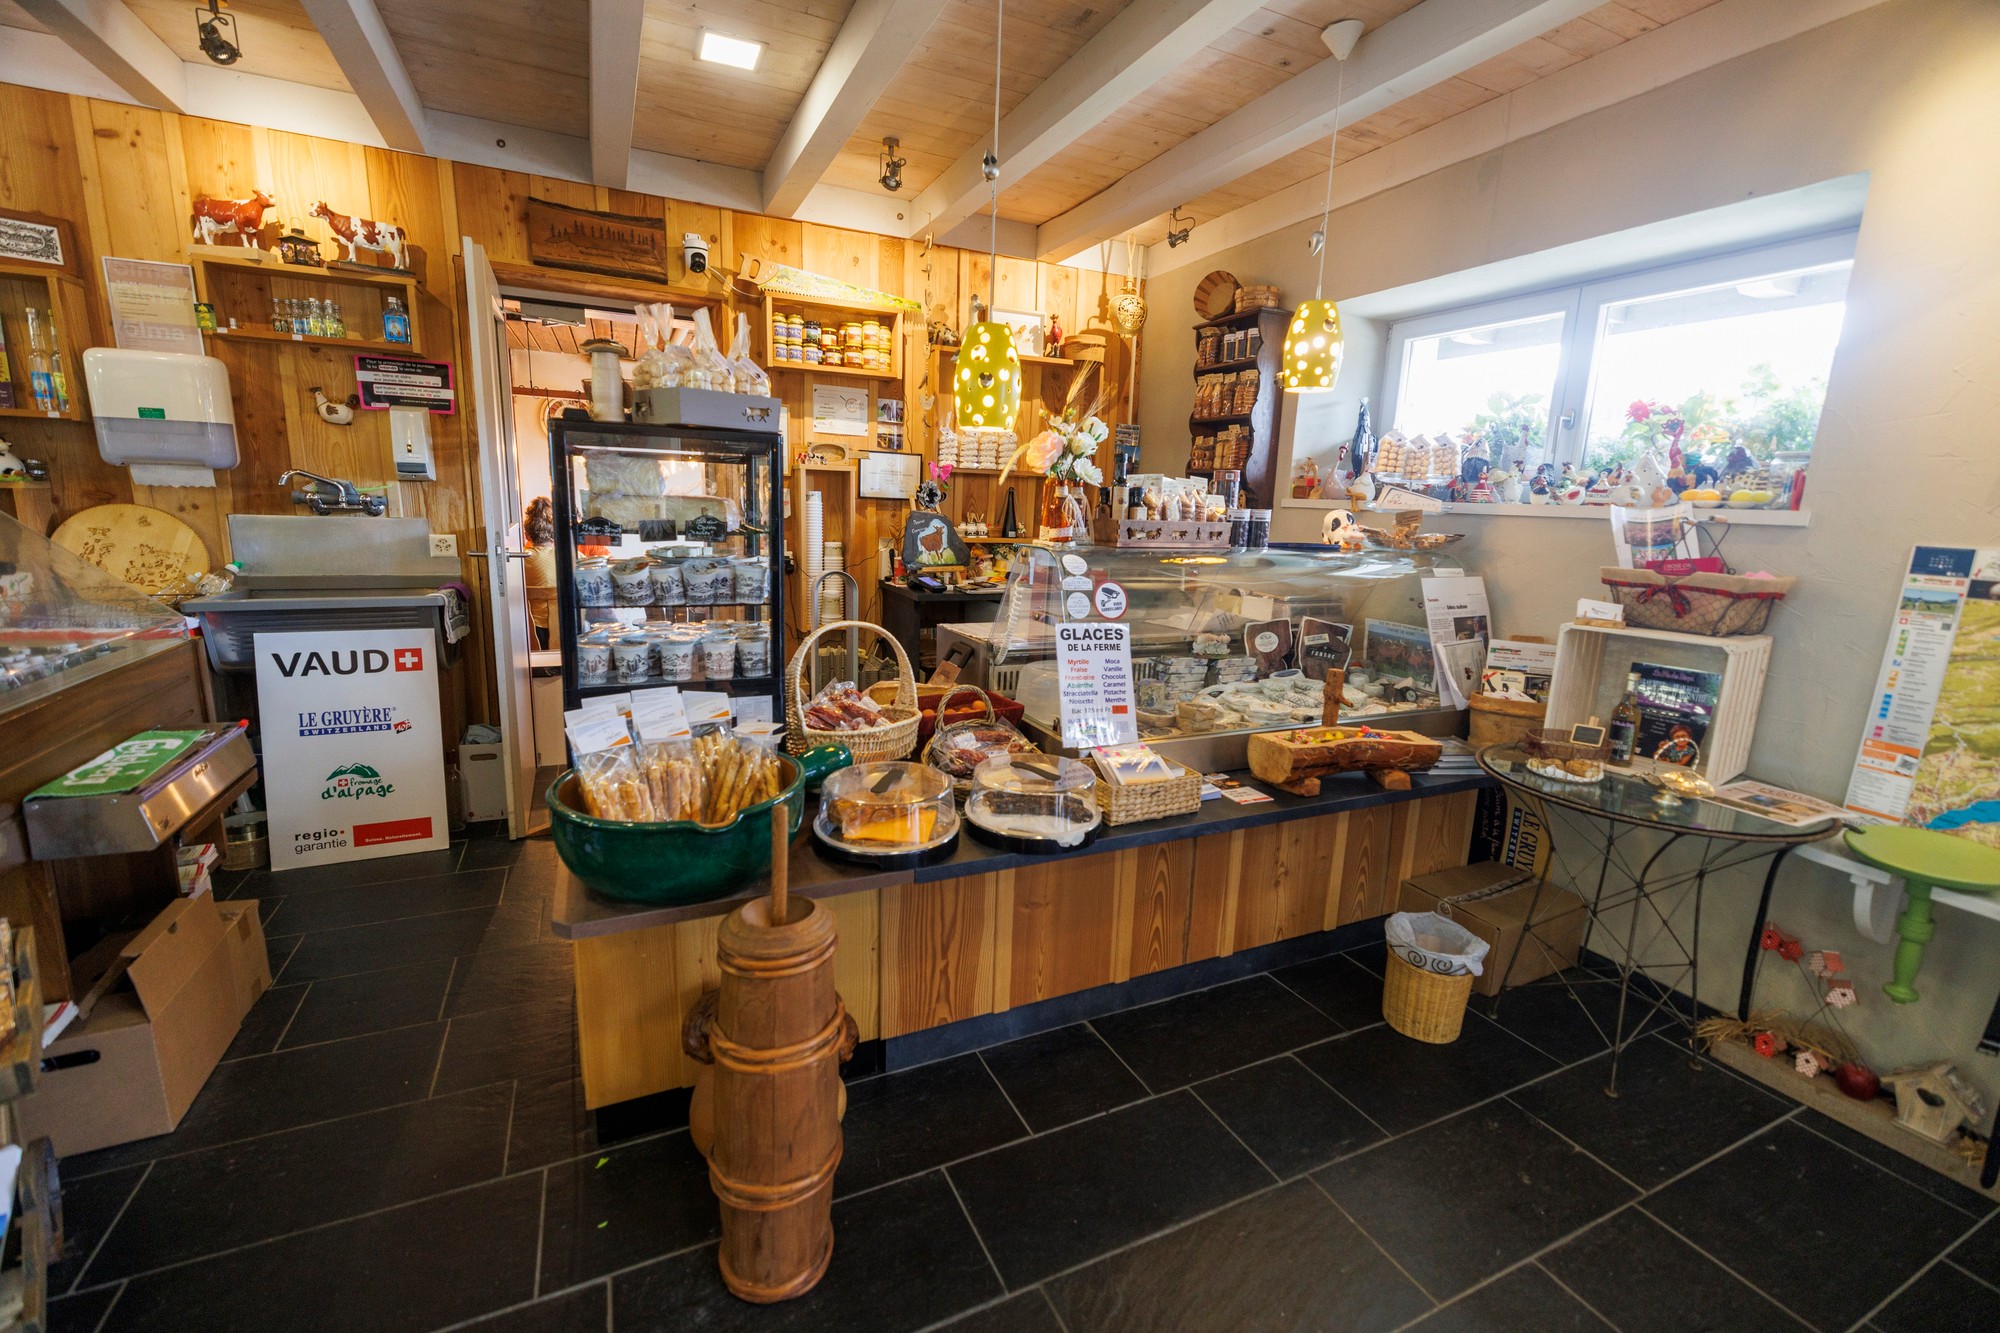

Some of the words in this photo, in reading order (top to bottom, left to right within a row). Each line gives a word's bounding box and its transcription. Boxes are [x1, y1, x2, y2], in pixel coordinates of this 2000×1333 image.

[1060, 628, 1124, 641] GLACES
[1067, 643, 1079, 652] DE
[1081, 643, 1092, 652] LA
[1093, 643, 1122, 651] FERME
[271, 649, 389, 678] VAUD
[1067, 658, 1090, 667] Myrtille
[298, 712, 318, 729] LE
[321, 706, 392, 728] GRUYÈRE
[303, 724, 388, 736] SWITZERLAND
[396, 722, 412, 734] AOP
[350, 777, 382, 787] fromage
[321, 783, 395, 800] d'alpage
[1523, 810, 1540, 831] LE
[294, 838, 347, 855] garantie
[1515, 831, 1538, 873] GRUY
